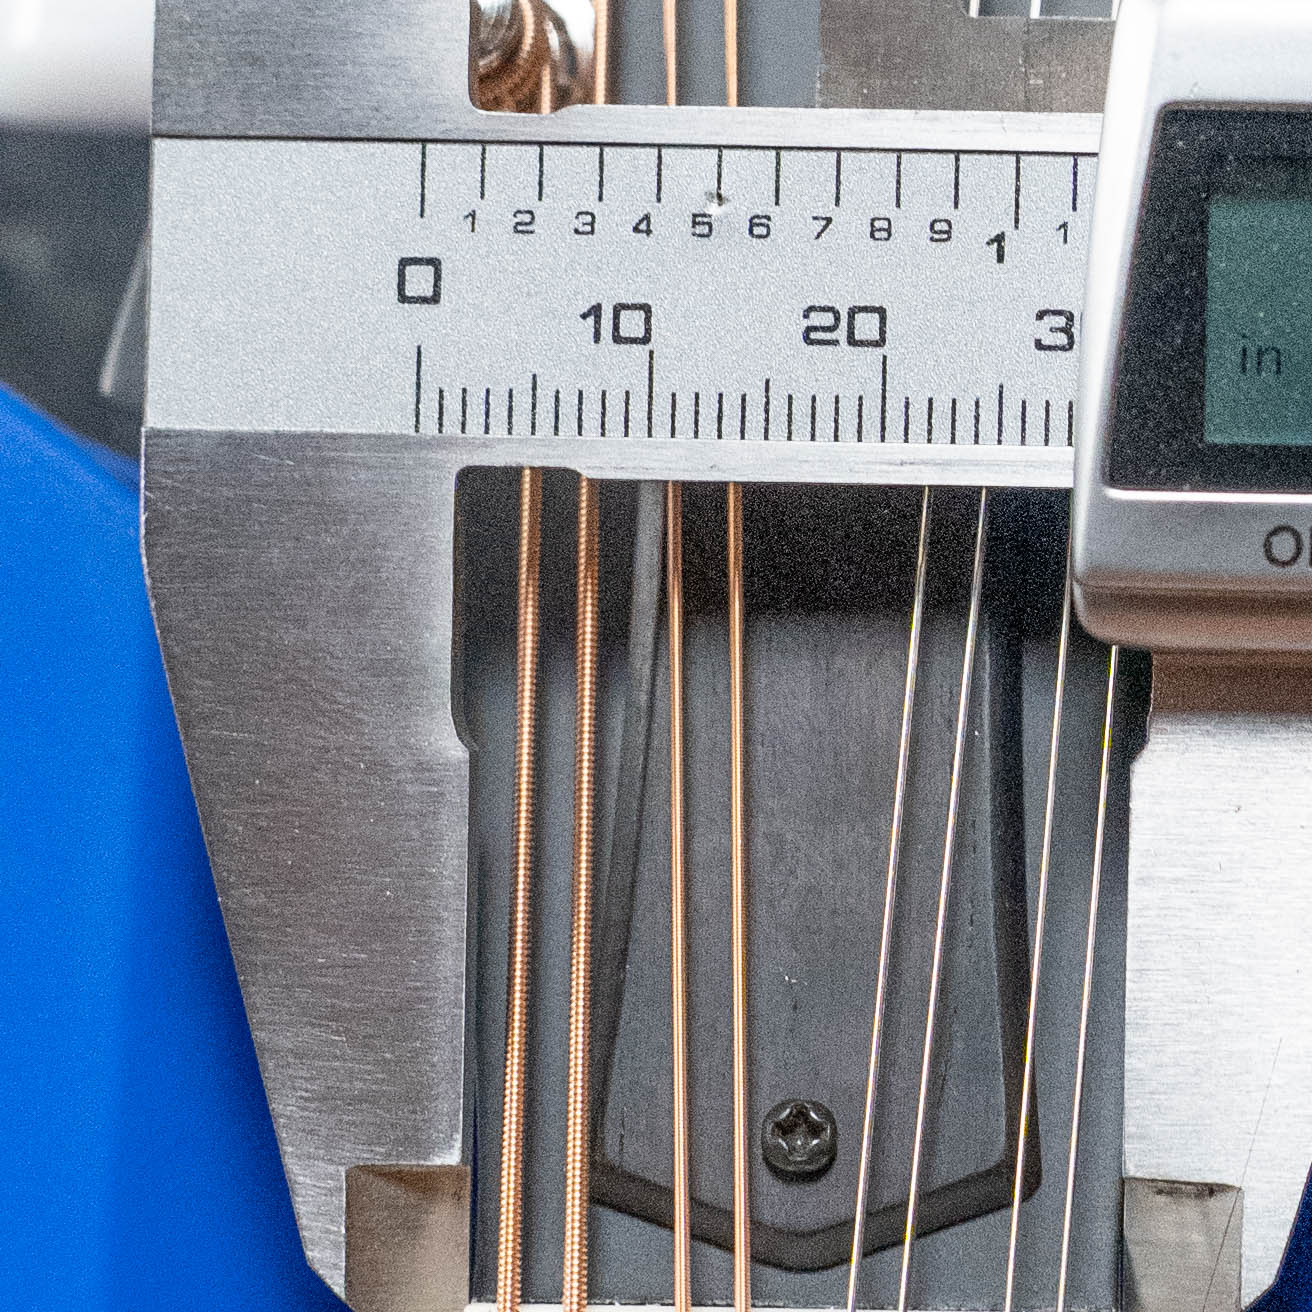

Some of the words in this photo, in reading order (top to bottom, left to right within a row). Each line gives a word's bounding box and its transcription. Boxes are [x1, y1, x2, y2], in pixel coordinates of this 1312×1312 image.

[463, 208, 478, 234] 1
[512, 208, 537, 236] 2
[573, 210, 598, 237] 3
[632, 212, 654, 239] 4
[691, 212, 714, 239] 5
[748, 213, 772, 240] 6
[811, 215, 834, 241] 7
[869, 216, 893, 242] 8
[929, 218, 953, 244] 9
[985, 231, 1006, 265] 1
[1055, 221, 1069, 245] 1
[396, 256, 443, 306] 0
[579, 302, 653, 346] 10
[802, 304, 888, 349] 20
[1034, 308, 1083, 353] 3
[1240, 333, 1282, 376] in
